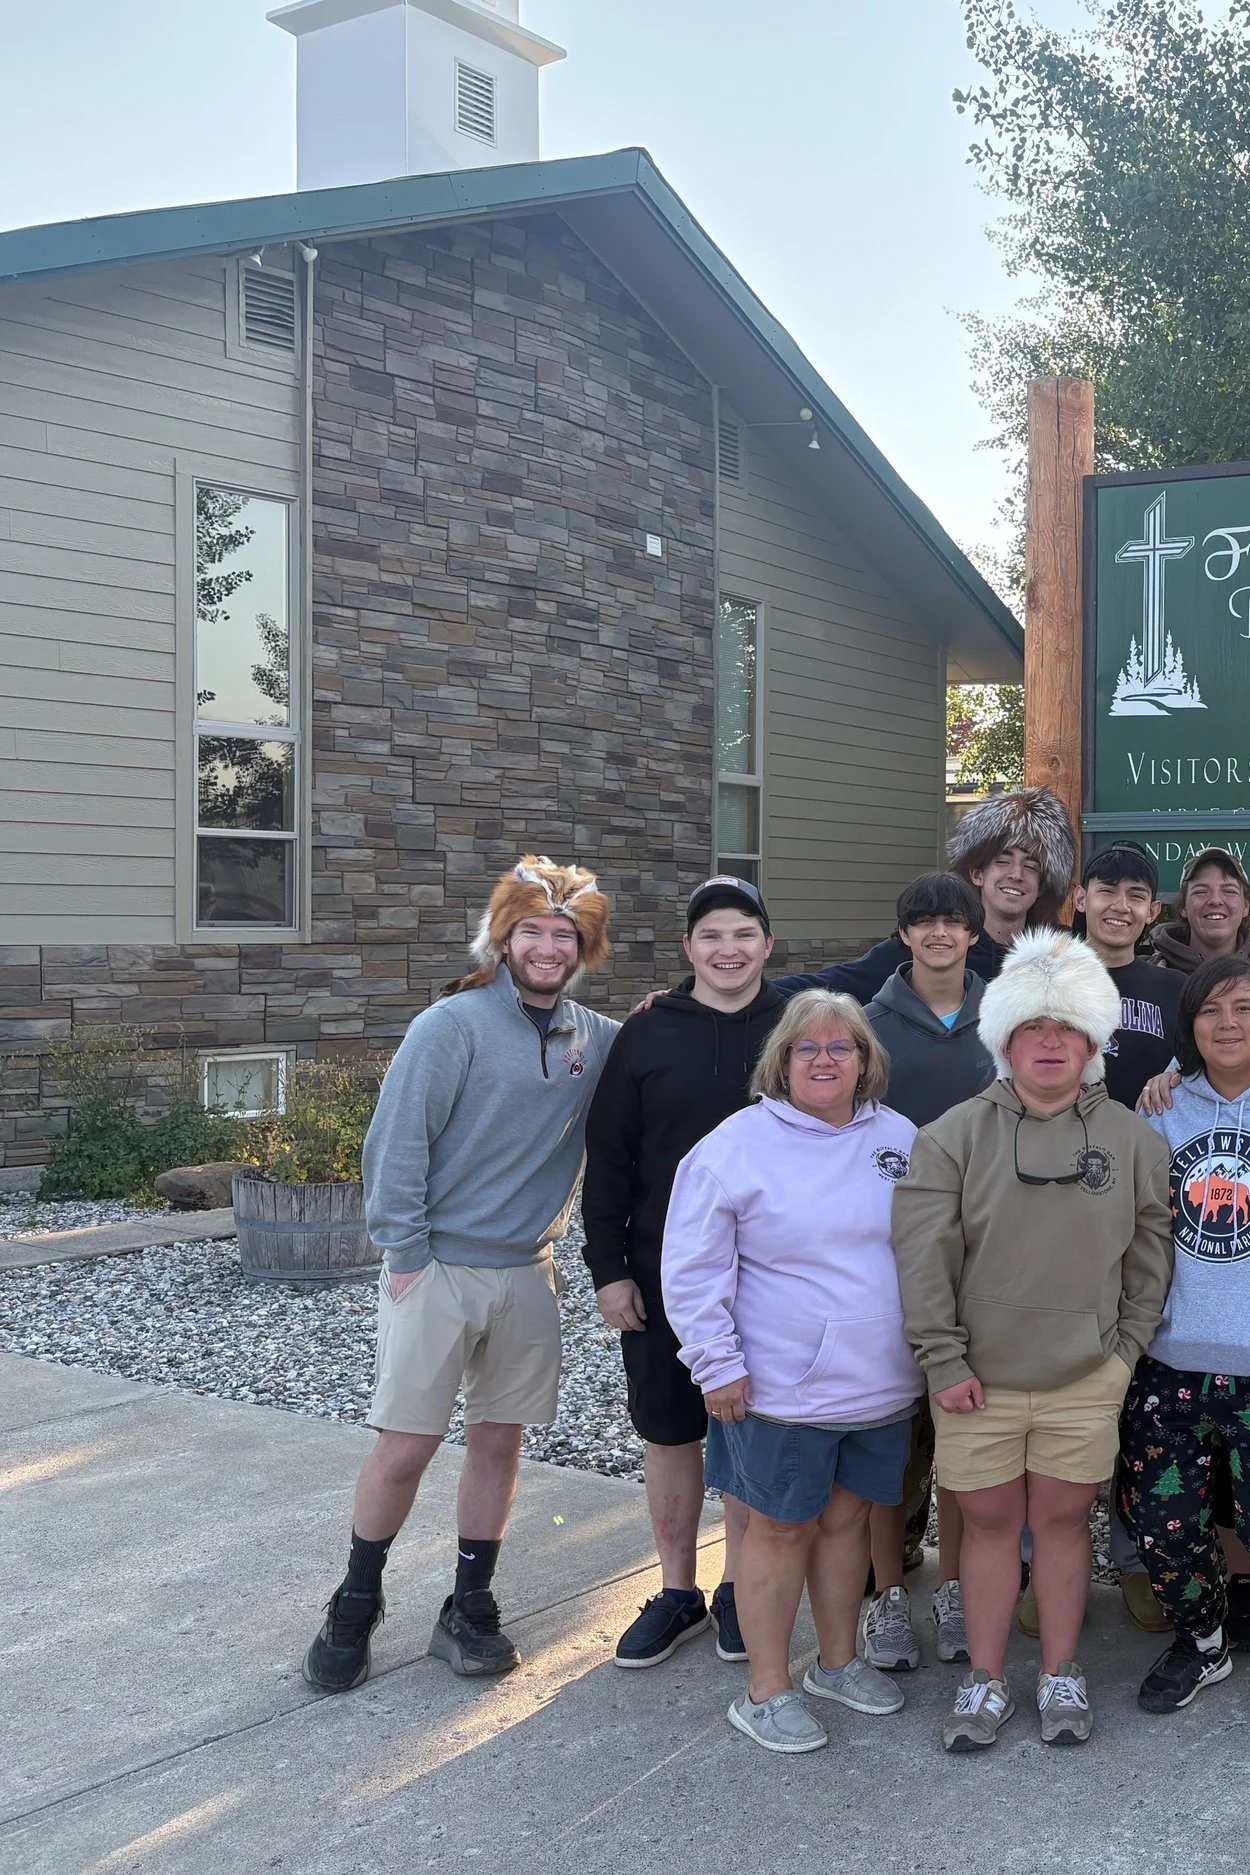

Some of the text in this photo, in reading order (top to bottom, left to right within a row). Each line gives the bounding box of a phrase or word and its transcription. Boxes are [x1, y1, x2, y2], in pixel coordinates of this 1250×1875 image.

[1145, 842, 1211, 861] NDAY
[1121, 997, 1164, 1039] OLINA
[1210, 1188, 1233, 1200] 1872
[1178, 1226, 1227, 1254] NATONAL
